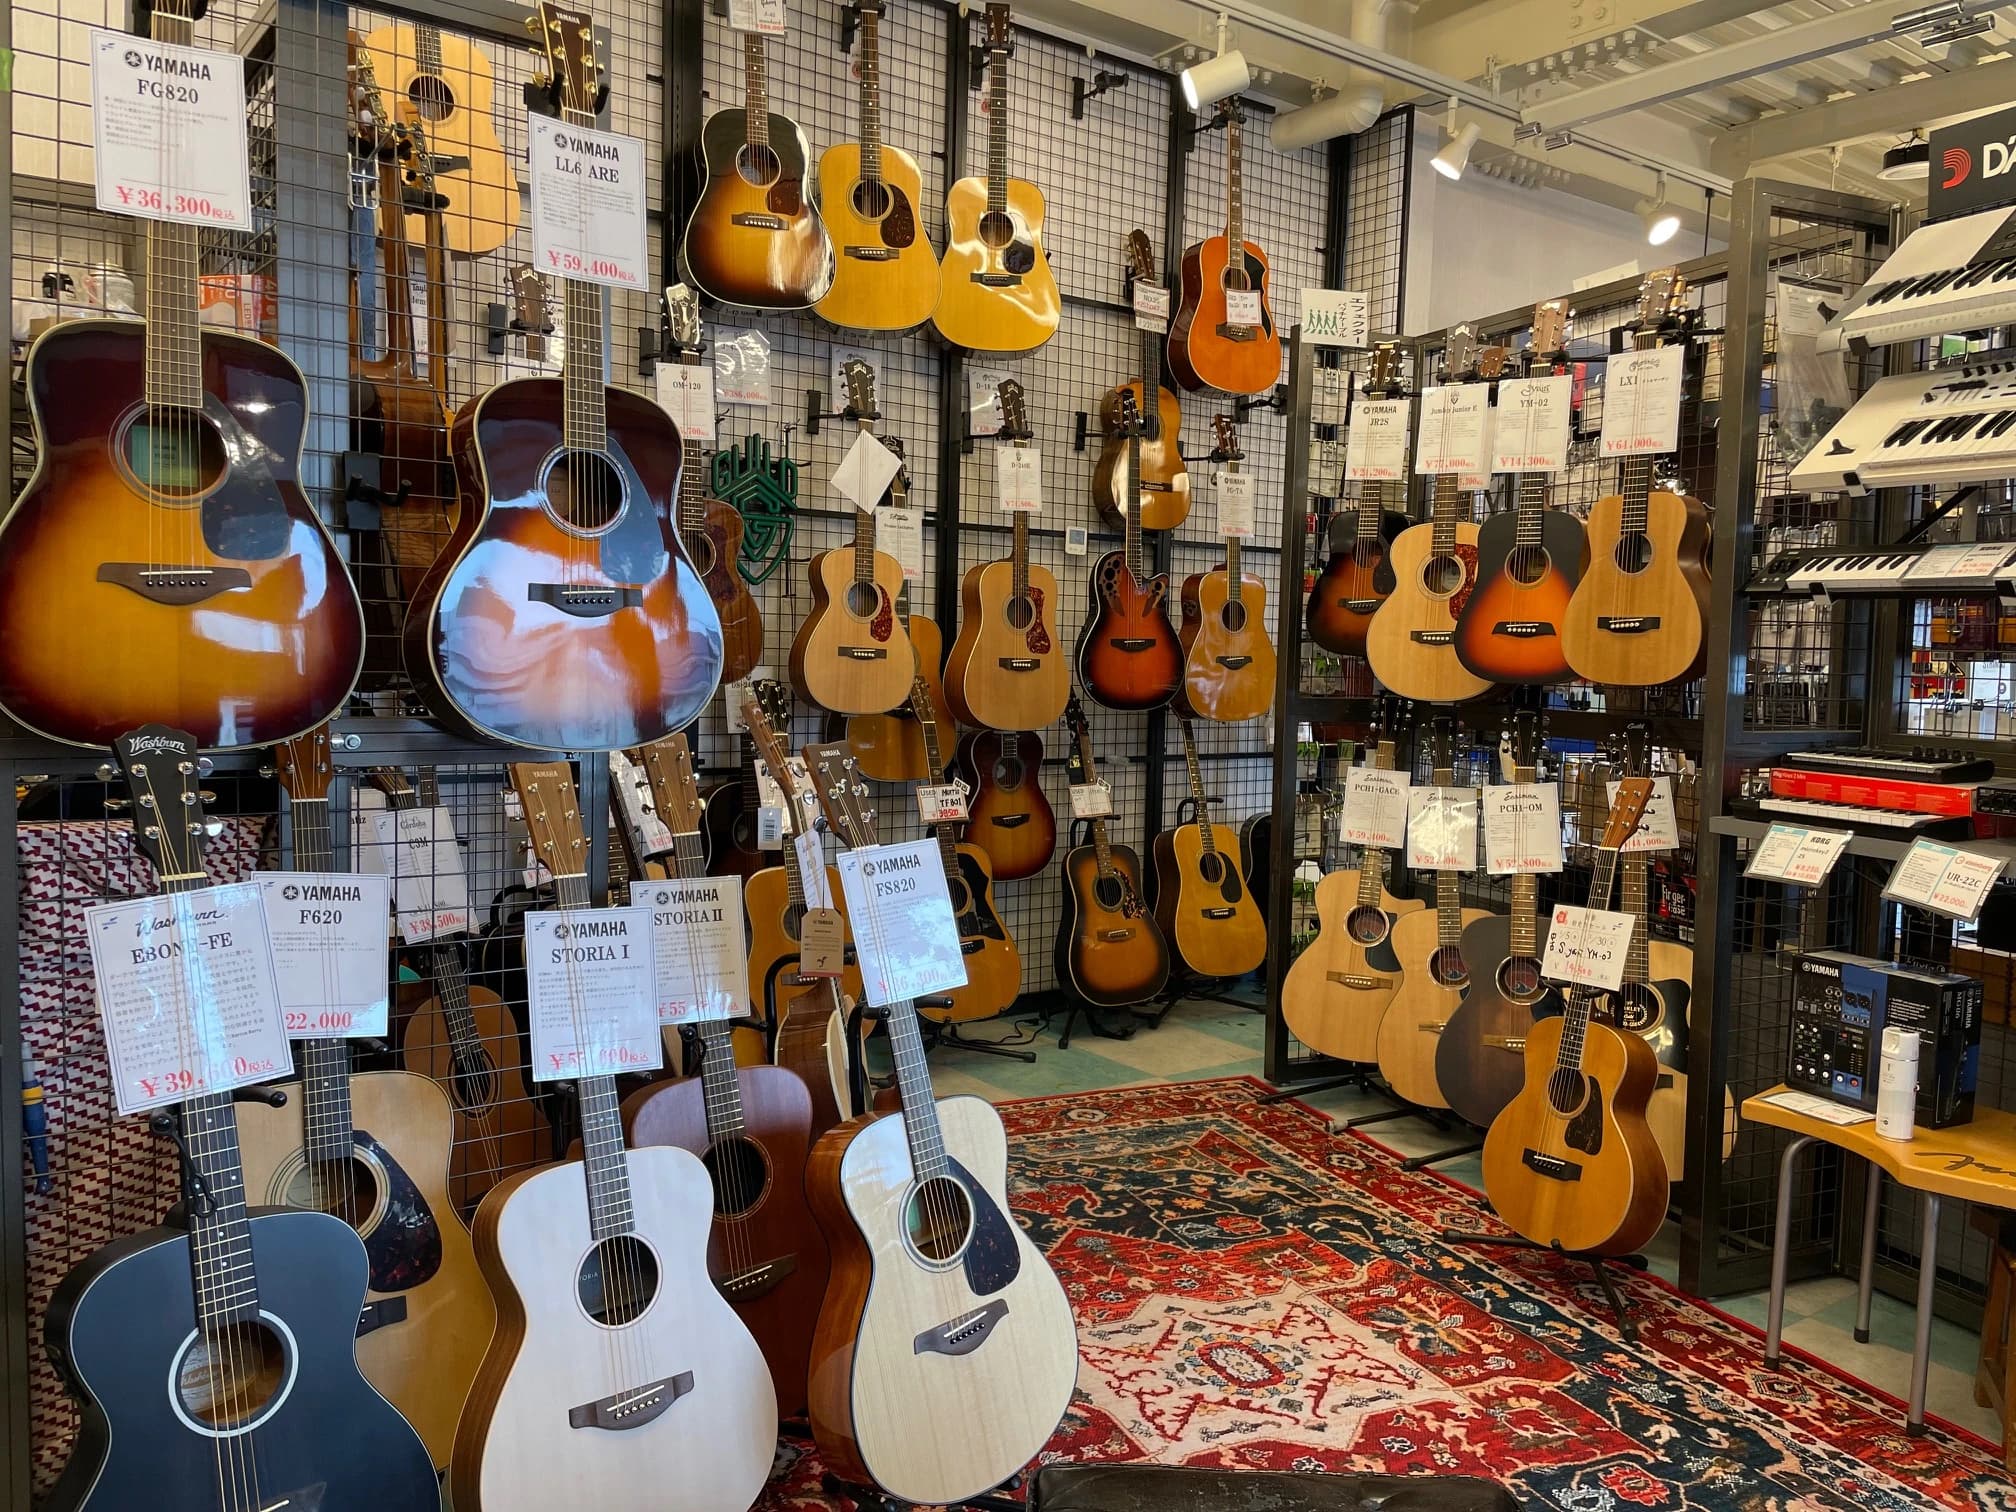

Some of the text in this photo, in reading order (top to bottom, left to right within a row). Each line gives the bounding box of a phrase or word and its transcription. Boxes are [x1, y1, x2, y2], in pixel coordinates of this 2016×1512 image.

[556, 12, 580, 25] YAMAHA
[145, 54, 212, 81] YAMAHA
[137, 79, 199, 104] FG820
[569, 136, 620, 162] YAMAHA
[555, 156, 619, 183] LL6 ARE
[672, 381, 701, 391] OM-120
[1370, 406, 1397, 415] YAMAHA
[1520, 399, 1548, 408] YM-02
[1370, 418, 1389, 426] JR2S
[129, 736, 186, 752] Washburn
[1810, 836, 1831, 845] KORG
[875, 853, 921, 874] YAMAHA
[875, 877, 916, 897] FS820
[1947, 872, 1982, 888] UR-22C
[302, 886, 361, 901] YAMAHA
[671, 889, 719, 904] YAMAHA
[299, 910, 343, 924] F620
[654, 909, 724, 926] STORIA II
[571, 921, 627, 938] YAMAHA
[131, 932, 233, 964] EBON-FE
[552, 944, 630, 963] STORIA I
[1810, 963, 1839, 978] YAMAHA
[580, 1271, 598, 1281] ORIA
